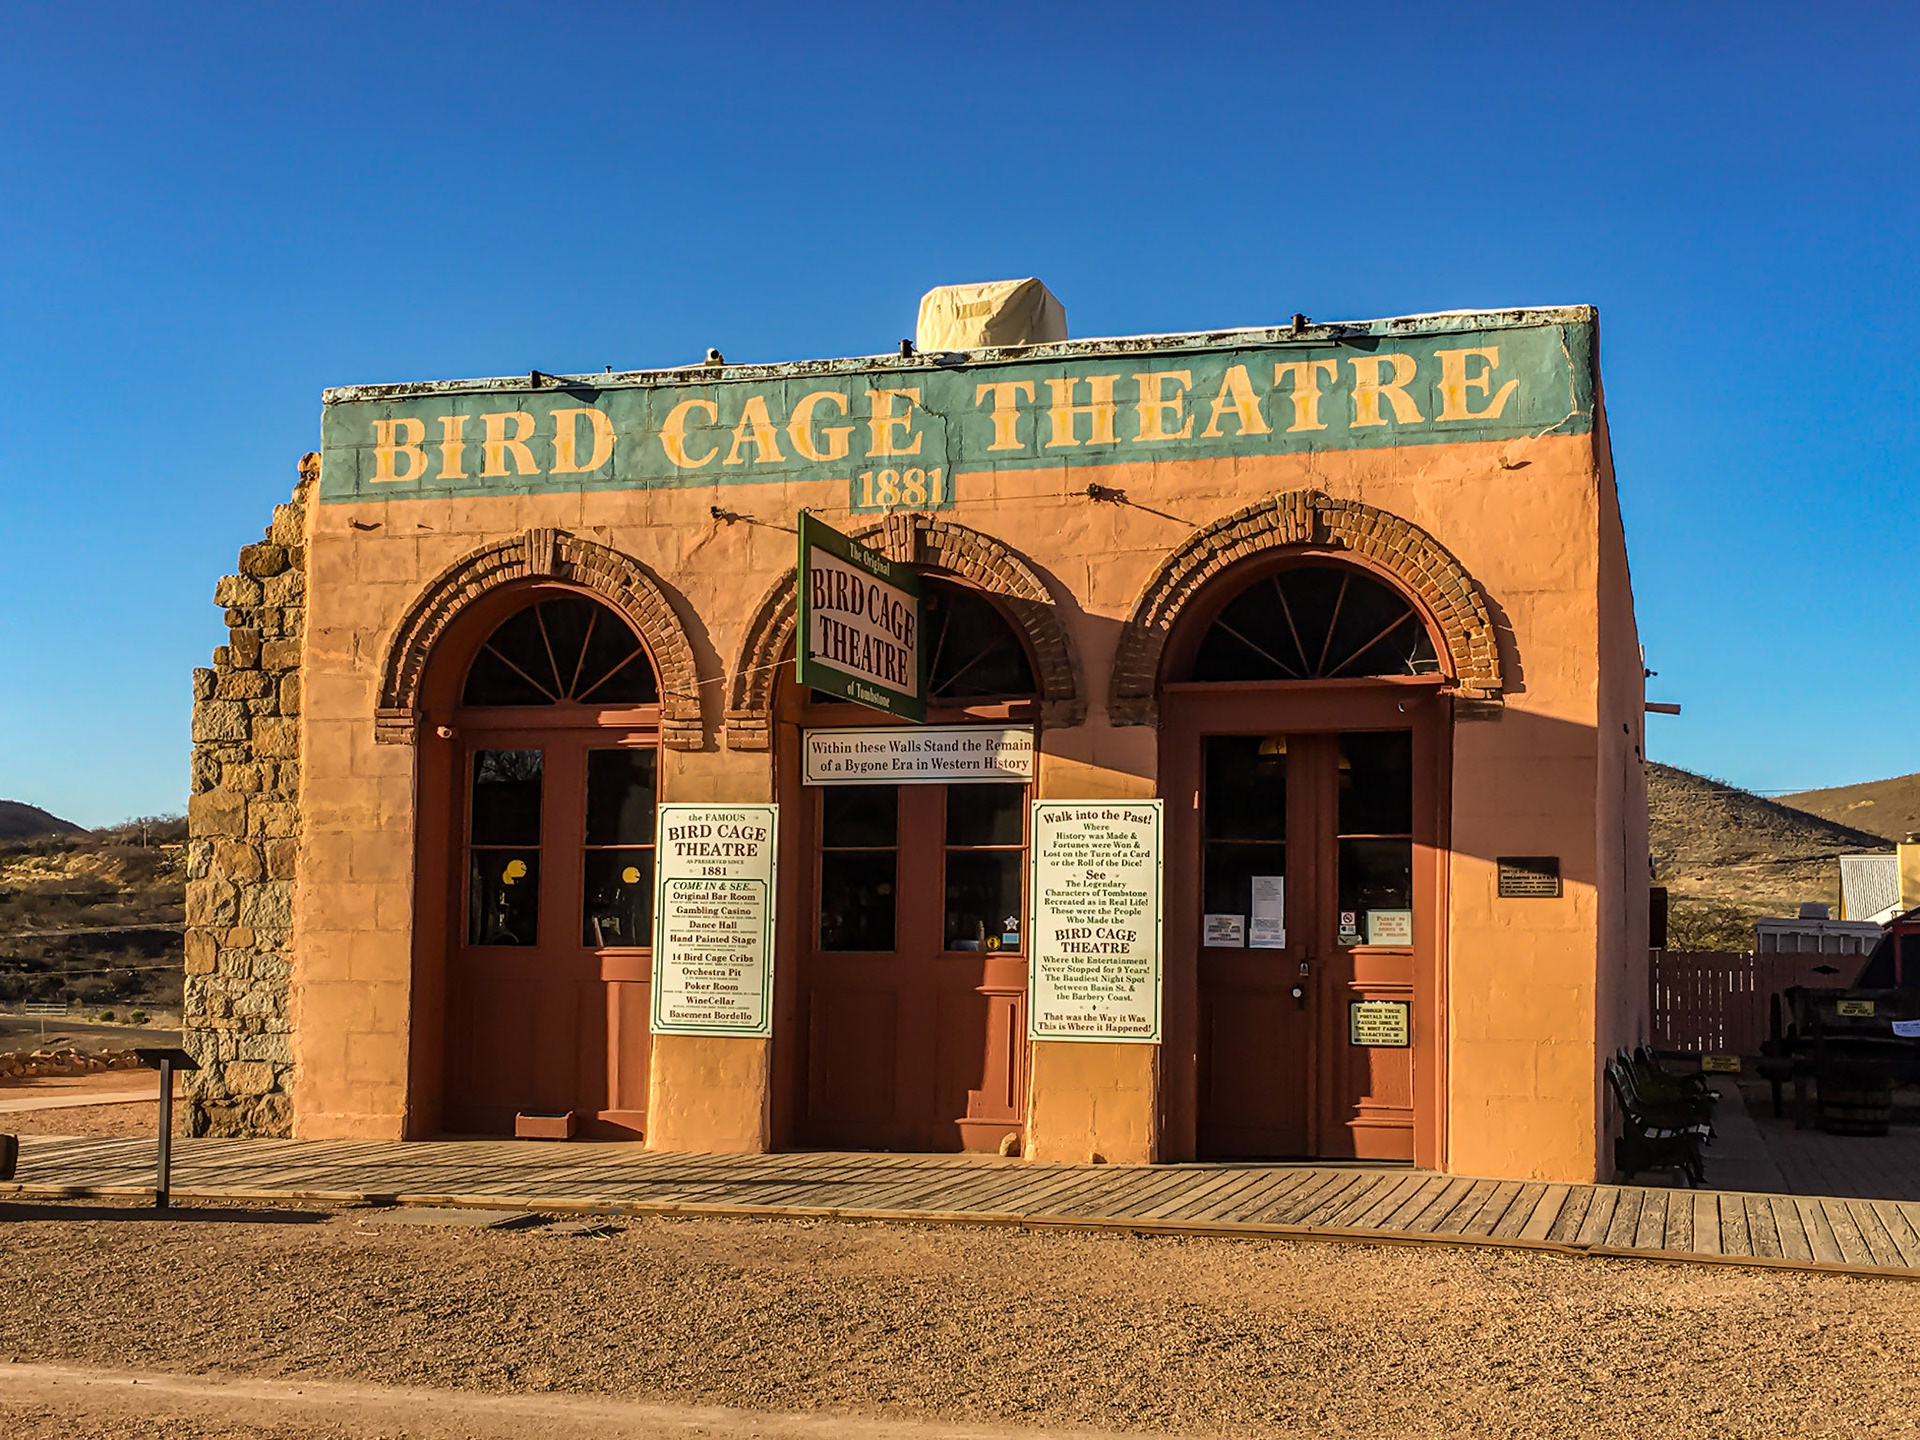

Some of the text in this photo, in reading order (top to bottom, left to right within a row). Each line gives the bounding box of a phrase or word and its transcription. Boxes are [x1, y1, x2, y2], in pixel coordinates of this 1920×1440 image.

[369, 346, 1518, 484] BIRD CAGE THEATRE
[858, 467, 944, 509] 1881
[850, 543, 890, 577] The Original
[811, 568, 915, 652] BIRD CAGE
[819, 615, 908, 687] THEATRE
[847, 681, 890, 708] of Tombstone
[812, 742, 851, 754] Within
[855, 741, 886, 753] these
[890, 740, 921, 752] Walls
[924, 740, 959, 752] Stand
[963, 739, 981, 751] the
[820, 757, 1028, 773] of a Bygone Era in Western History
[1043, 810, 1152, 824] Walk into the Past!
[668, 824, 767, 842] BIRD CAGE
[1056, 832, 1085, 840] History
[675, 843, 757, 856] THEATRE
[702, 867, 727, 875] 1881
[1086, 870, 1106, 880] See
[673, 882, 702, 890] COME
[704, 882, 717, 890] IN
[719, 882, 727, 890] &
[1083, 881, 1127, 889] Legendary
[673, 892, 708, 901] Original
[677, 906, 751, 915] Gambling Casino
[1114, 908, 1141, 916] People
[689, 921, 737, 929] Dance Hall
[696, 935, 729, 943] Painted
[731, 936, 756, 944] Stage
[1055, 928, 1136, 942] BIRD CAGE
[1061, 942, 1130, 953] THEATRE
[684, 953, 702, 961] Bird
[705, 954, 726, 963] Cage
[730, 954, 753, 962] Cribs
[682, 967, 725, 976] Orchestra
[1067, 965, 1100, 974] Stopped
[1124, 966, 1150, 974] Years!
[1101, 975, 1123, 983] Night
[1126, 976, 1145, 984] Spot
[685, 982, 738, 990] Poker Room
[686, 996, 735, 1005] WineCellar
[1072, 993, 1104, 1002] Barbery
[669, 1010, 752, 1020] Basement Bordello
[1099, 1014, 1117, 1023] Way
[1105, 1024, 1151, 1033] Happened!
